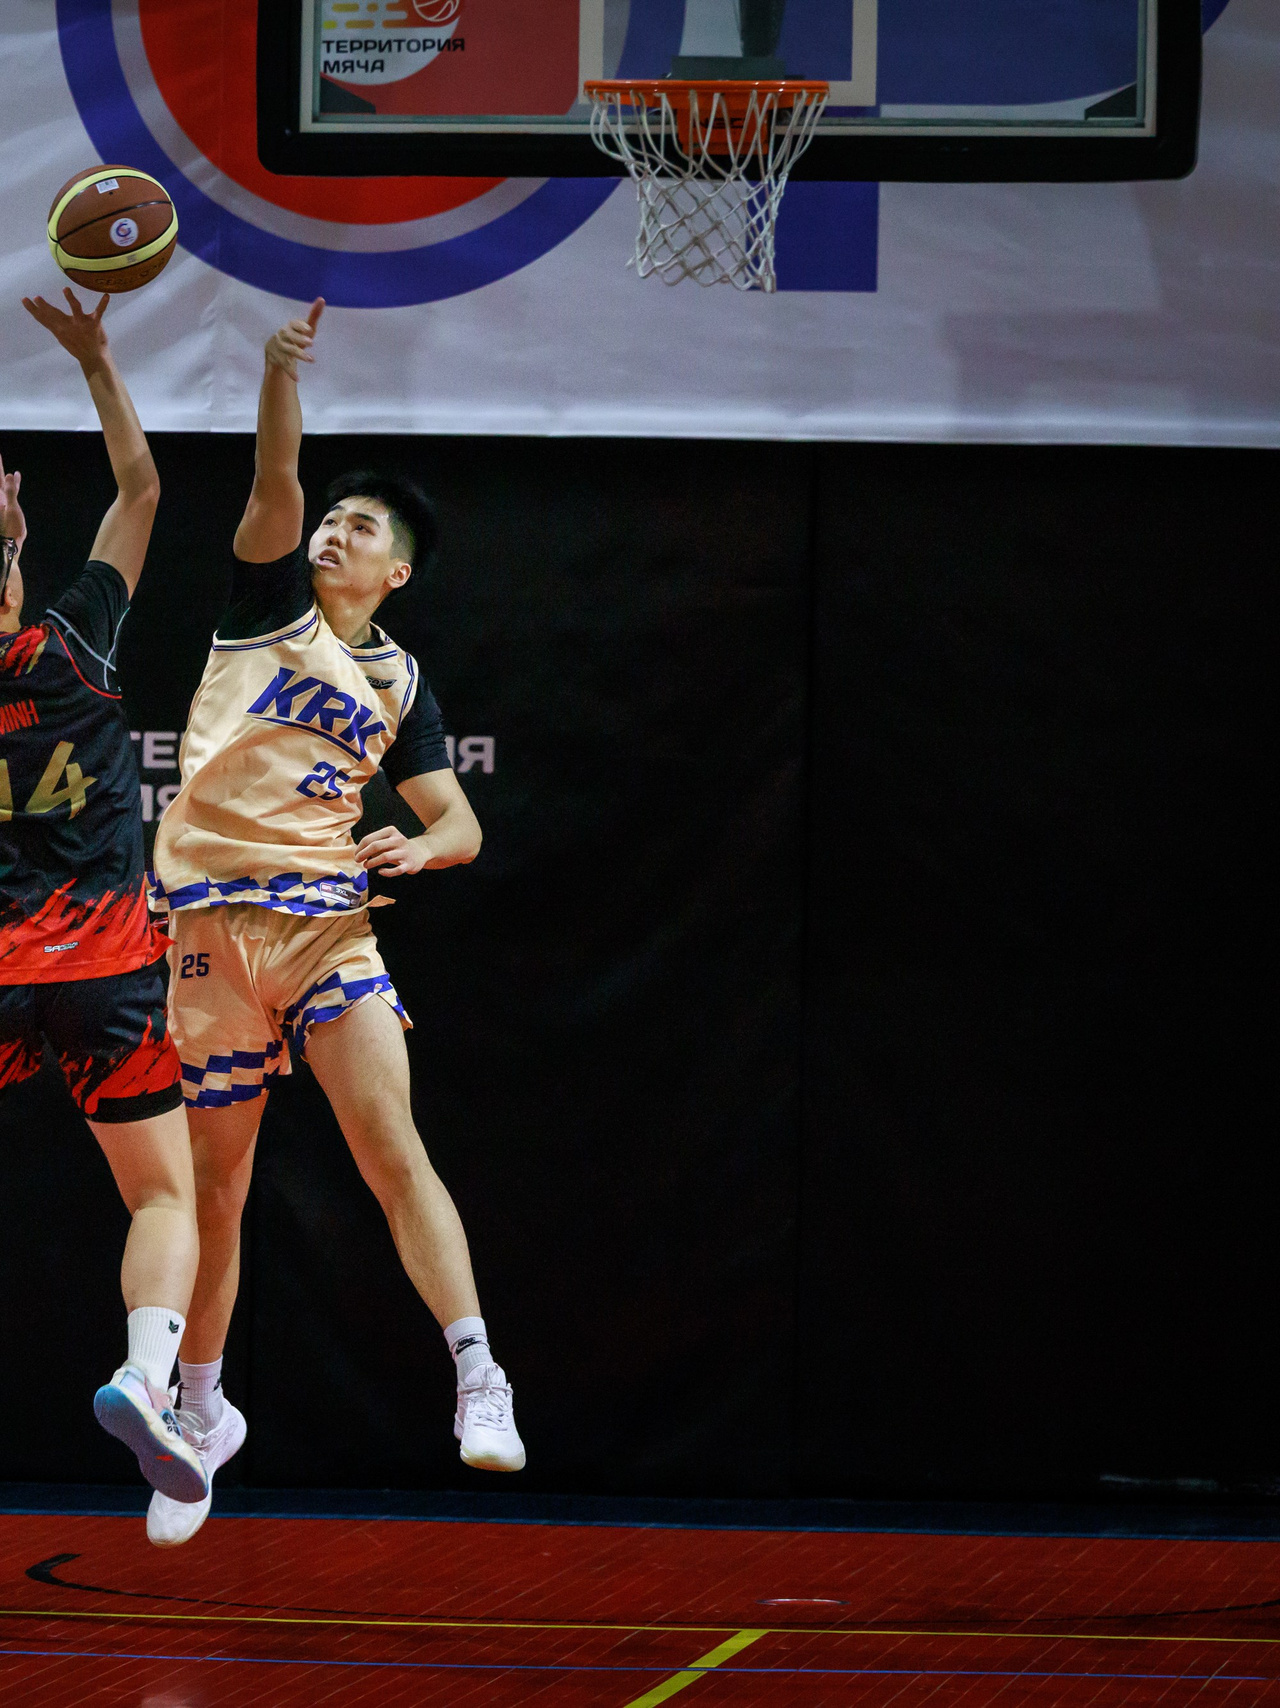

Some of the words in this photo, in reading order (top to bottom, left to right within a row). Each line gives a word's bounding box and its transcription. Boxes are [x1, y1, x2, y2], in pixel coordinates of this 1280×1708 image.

[322, 38, 466, 54] ТЕРРИТОРИЯ
[323, 59, 385, 74] МЯЧА
[246, 666, 387, 762] KRK
[295, 761, 351, 801] 25
[181, 952, 211, 979] 25
